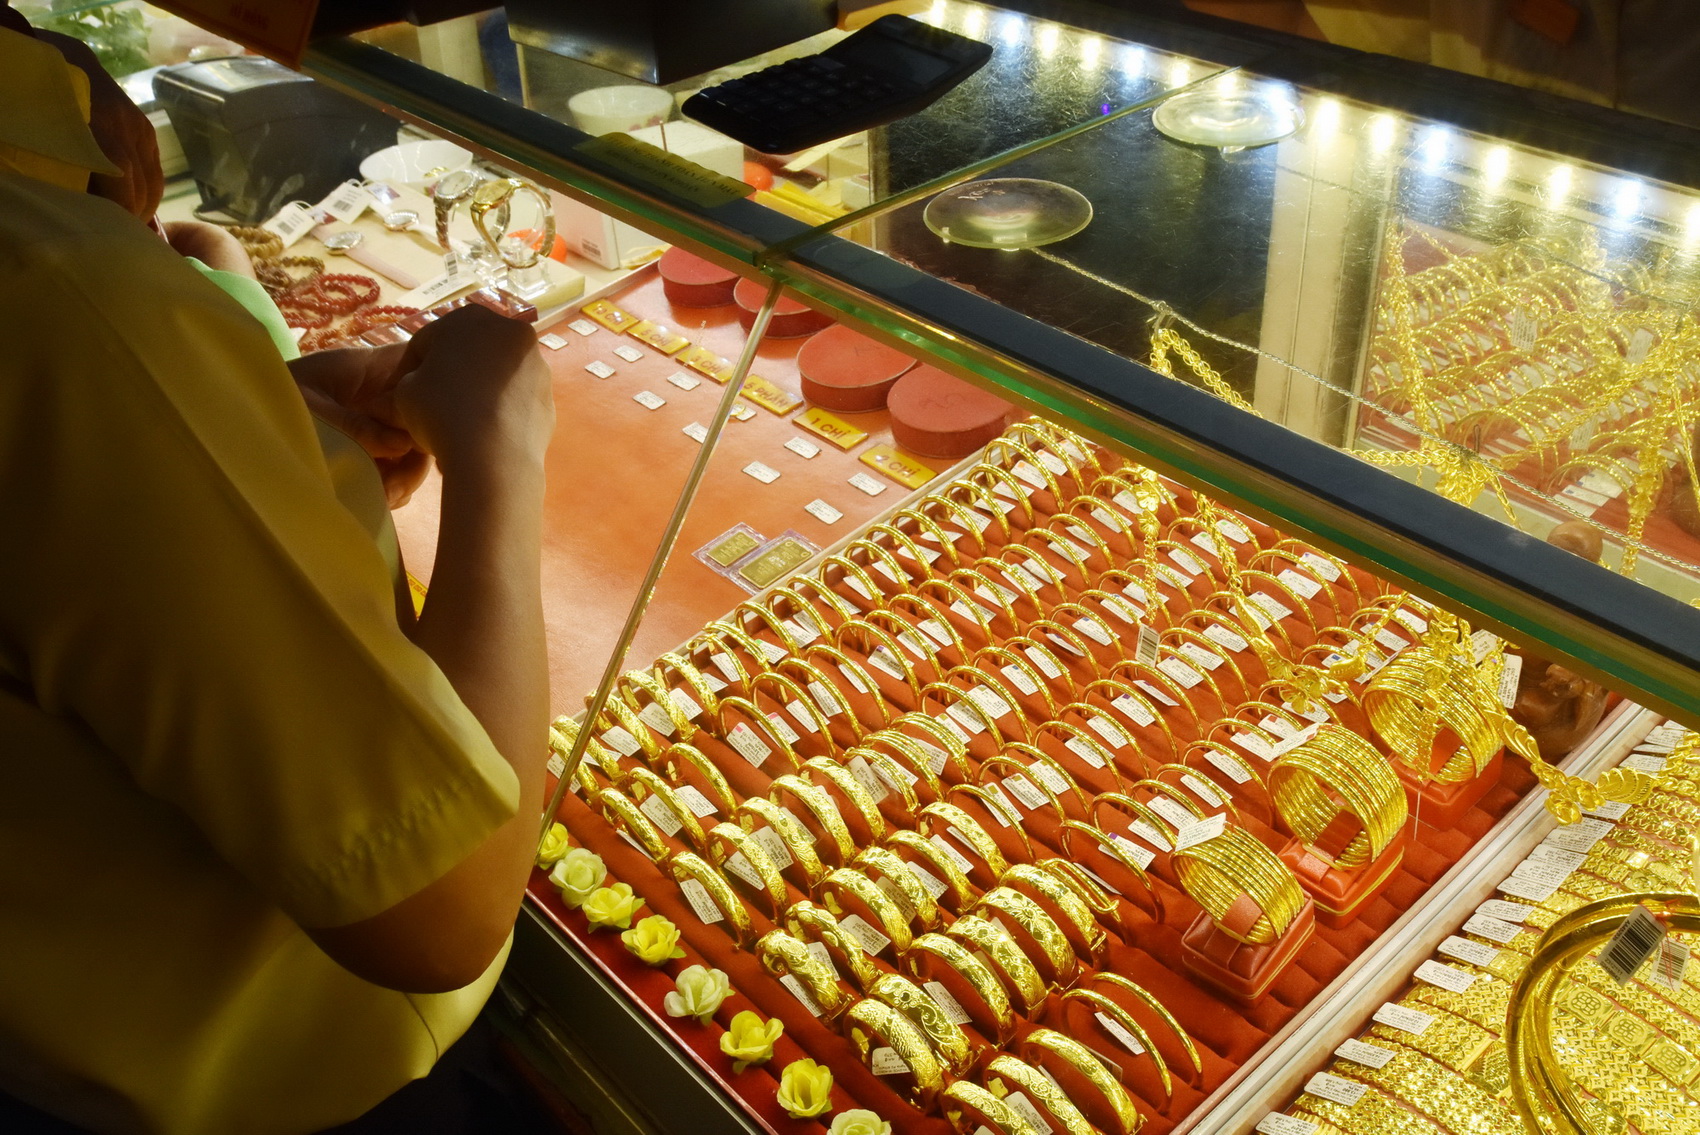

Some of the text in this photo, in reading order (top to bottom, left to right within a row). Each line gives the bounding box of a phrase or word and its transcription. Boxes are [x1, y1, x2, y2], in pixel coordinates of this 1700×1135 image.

[640, 329, 653, 338] 5
[690, 355, 702, 364] 3
[743, 381, 756, 390] 5
[810, 417, 822, 425] 1
